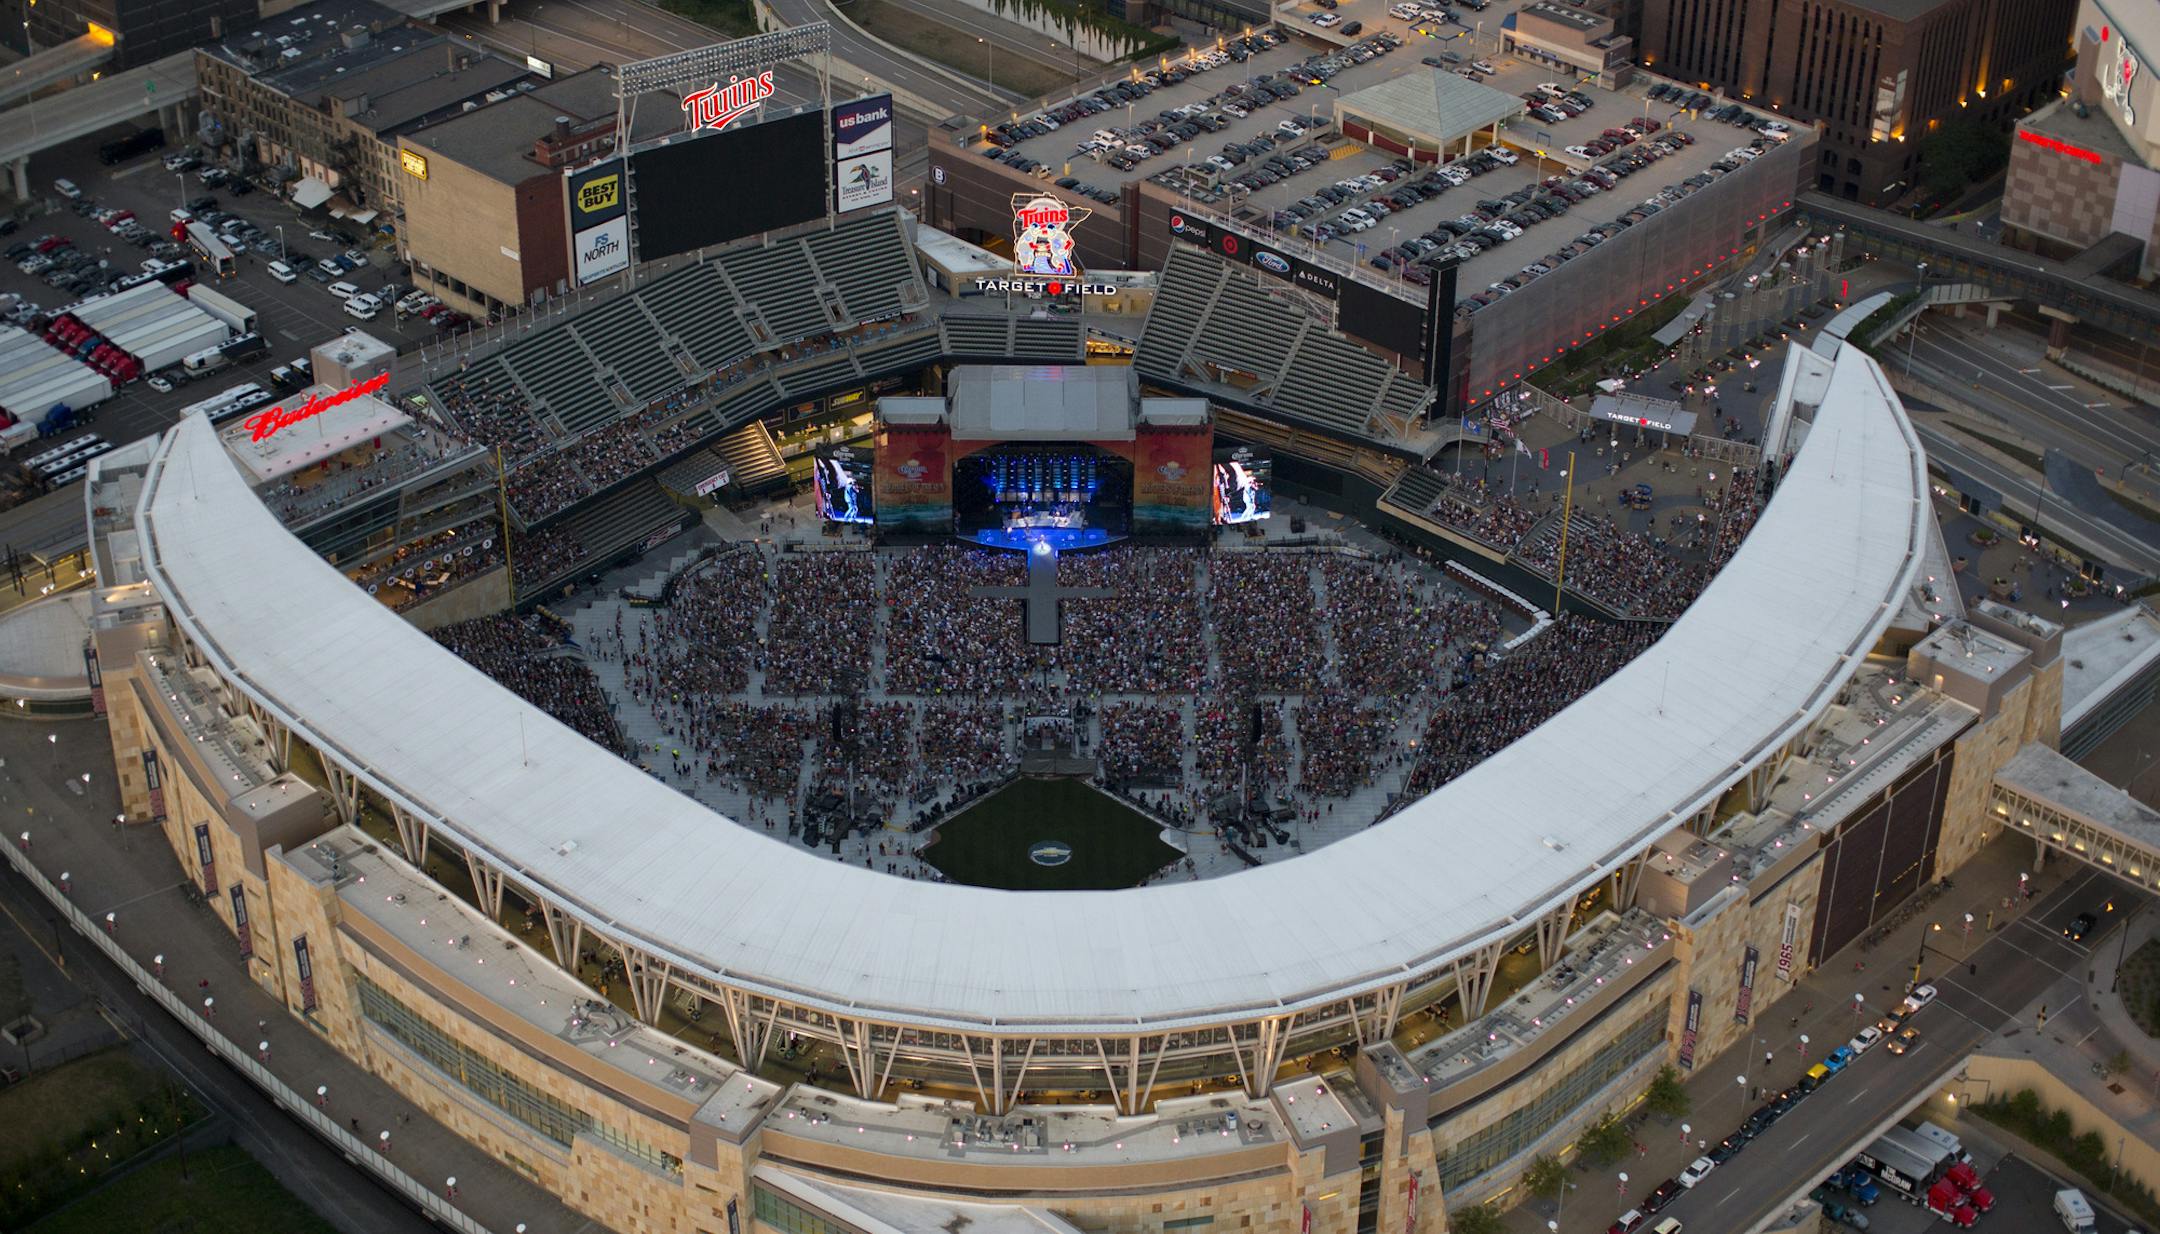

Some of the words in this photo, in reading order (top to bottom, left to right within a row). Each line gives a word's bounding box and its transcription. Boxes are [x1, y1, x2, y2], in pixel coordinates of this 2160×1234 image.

[681, 70, 775, 133] Twins
[934, 167, 944, 182] B
[583, 180, 617, 198] BEST
[584, 191, 614, 208] BUY
[1016, 207, 1069, 230] Twins
[1184, 224, 1207, 238] pepsi
[595, 232, 609, 248] FS
[583, 240, 620, 264] NORTH
[1261, 255, 1284, 272] Ford
[975, 279, 1046, 293] TARGET
[1064, 283, 1117, 296] FIELD
[1306, 273, 1335, 290] DELTA
[1607, 412, 1640, 424] TARGET
[1646, 419, 1672, 430] FIELD
[1777, 943, 1793, 973] 1965
